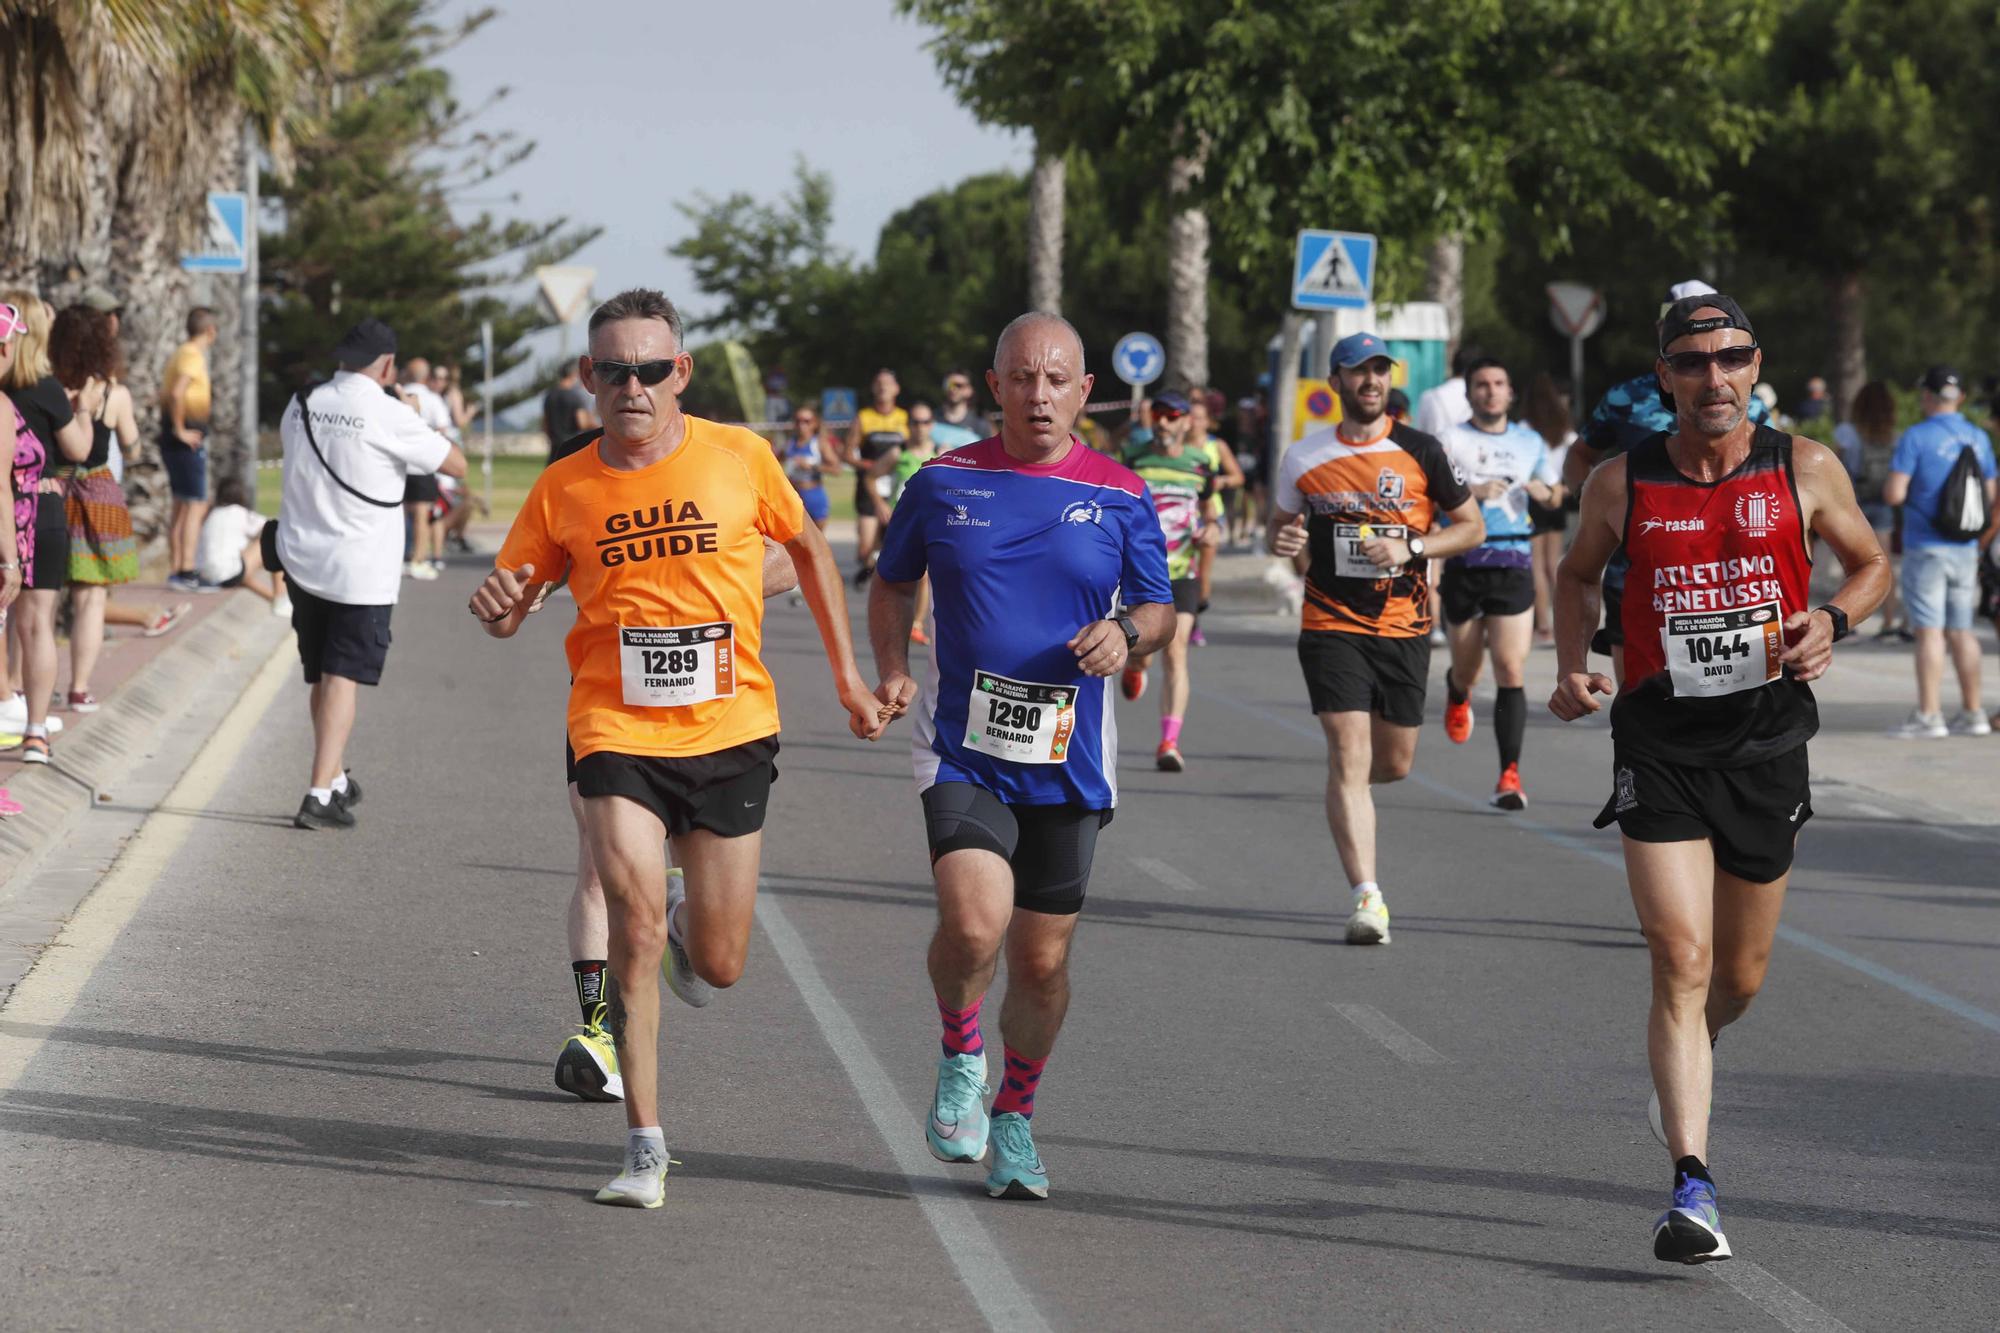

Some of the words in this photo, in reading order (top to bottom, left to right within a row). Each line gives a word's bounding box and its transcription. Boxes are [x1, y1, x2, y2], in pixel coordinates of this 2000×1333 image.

[291, 408, 365, 429] RNNING
[946, 488, 995, 499] momadesign
[605, 499, 703, 534] GUÍA
[946, 518, 970, 526] Natural
[971, 518, 991, 527] Hand
[1665, 517, 1705, 532] rasán
[600, 532, 718, 567] GUIDE
[1653, 554, 1775, 589] ATLETISMO
[1693, 616, 1725, 625] MARATÓN
[1699, 622, 1727, 631] PATERNA
[1685, 633, 1750, 664] 1044
[1767, 631, 1777, 649] BOX
[641, 648, 699, 674] 1289
[718, 647, 728, 664] BOX
[1704, 665, 1733, 676] DAVID
[644, 676, 695, 688] FERNANDO
[1000, 681, 1029, 694] MARATÓN
[1003, 689, 1029, 699] PATERNA
[988, 698, 1042, 732] 1290
[985, 725, 1034, 745] BERNARDO
